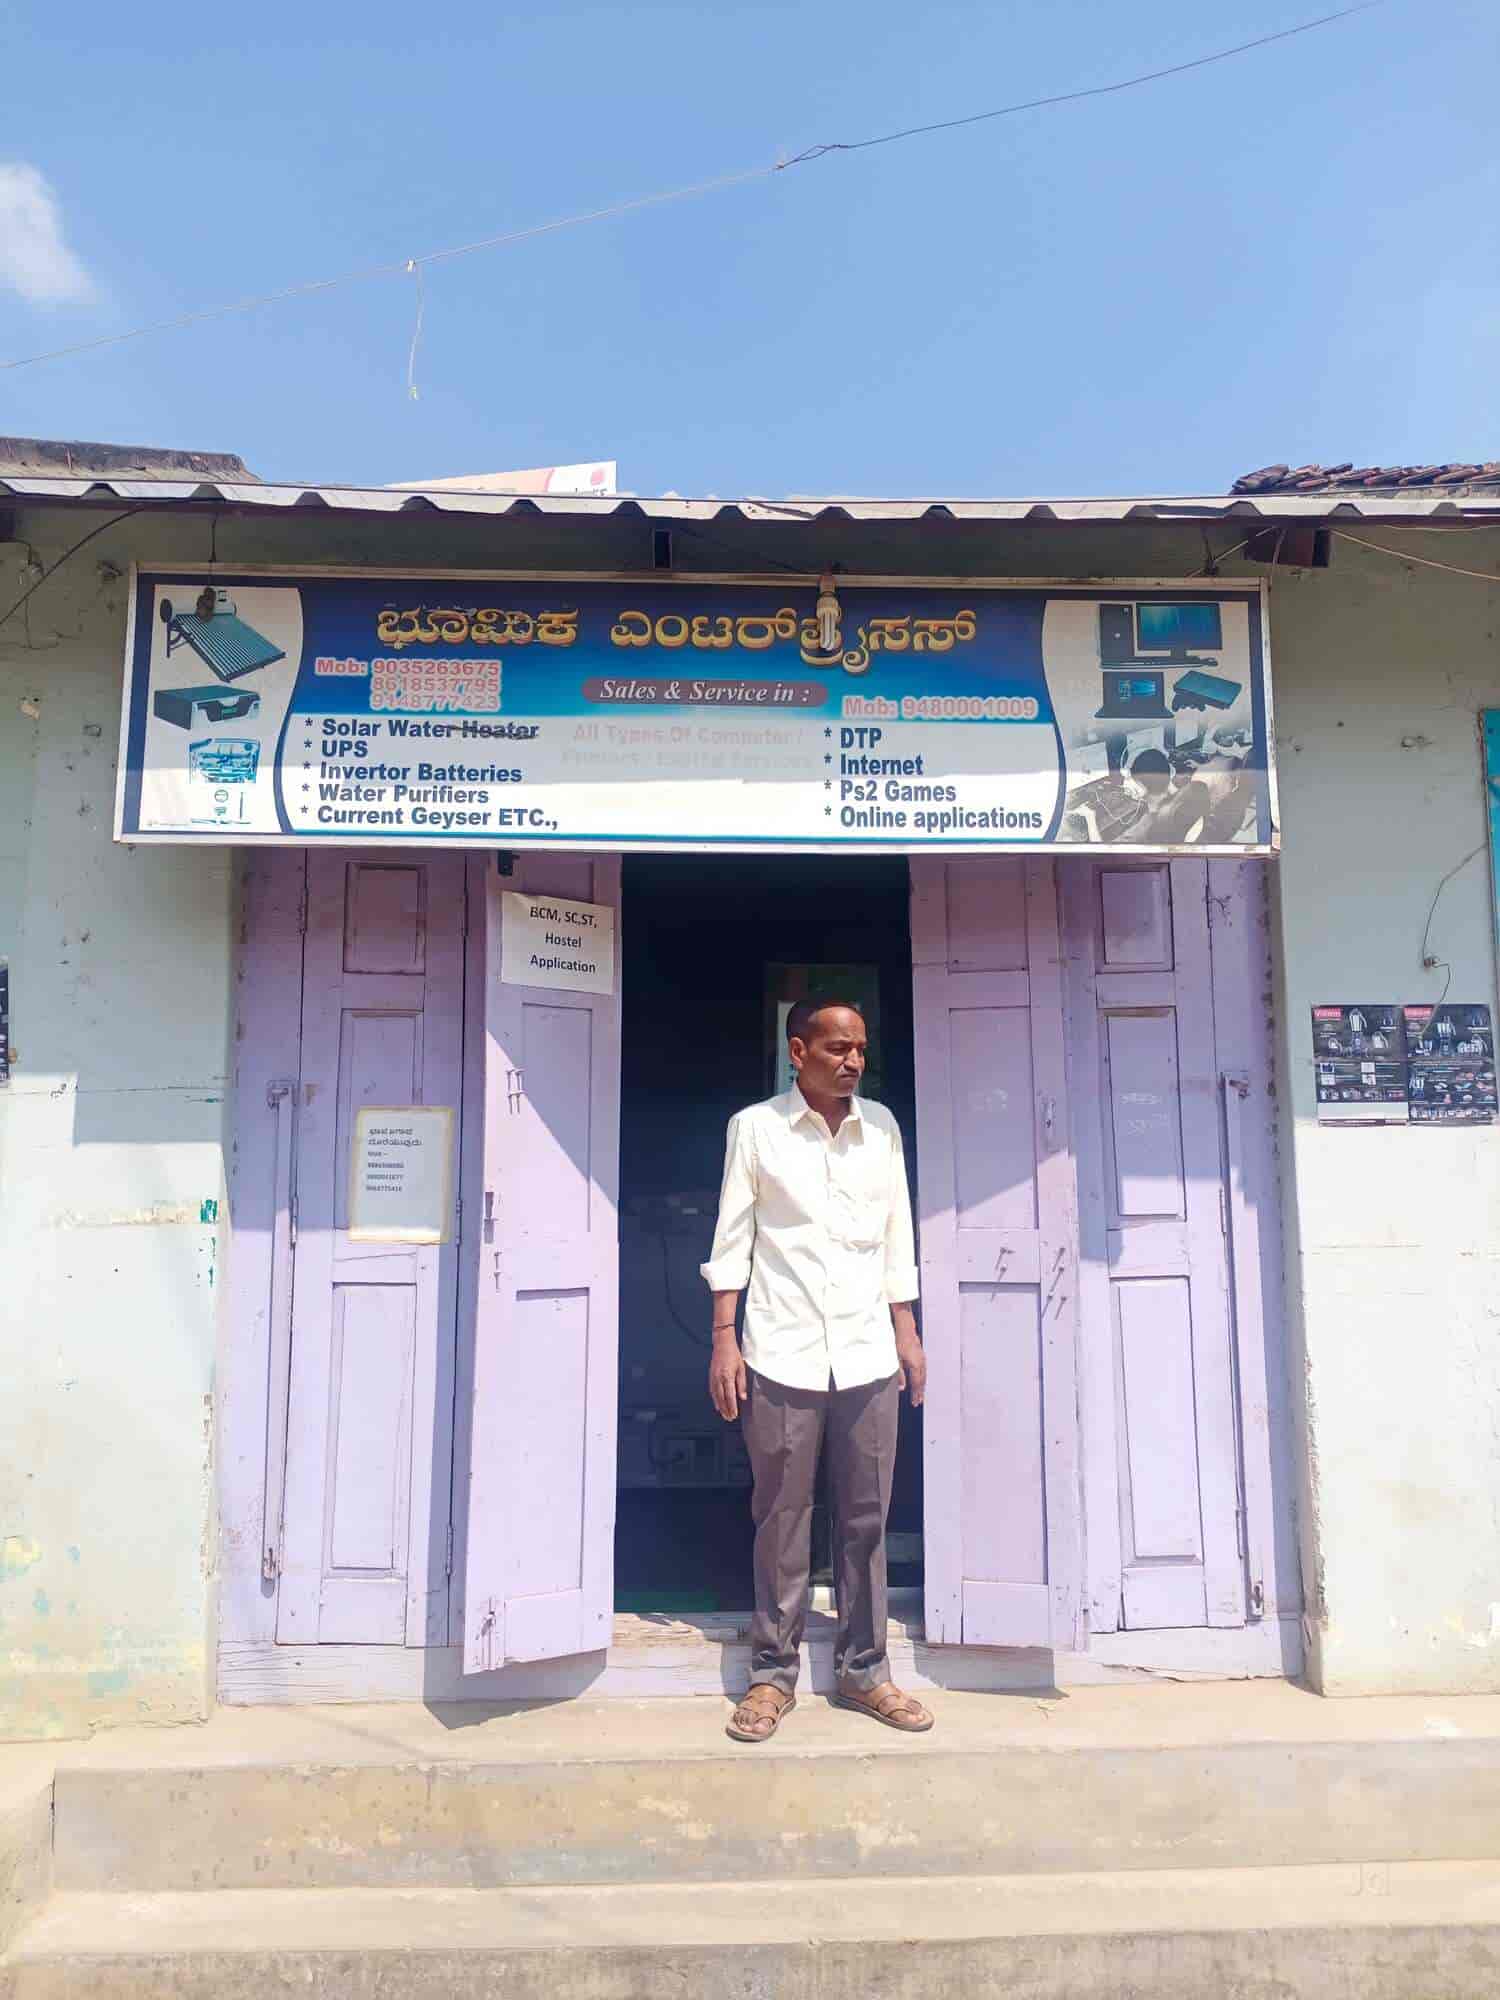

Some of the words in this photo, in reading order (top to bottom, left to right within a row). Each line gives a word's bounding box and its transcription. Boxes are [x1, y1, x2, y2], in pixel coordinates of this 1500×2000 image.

[315, 658, 367, 675] Mob:
[372, 659, 500, 676] 9035263675
[600, 680, 658, 700] Sales
[663, 681, 682, 700] &
[689, 681, 768, 702] Service
[843, 696, 897, 717] Mob:
[902, 697, 1037, 718] 9480001009
[322, 719, 381, 737] Solar
[388, 720, 453, 738] Water
[461, 720, 540, 739] Heater
[840, 727, 882, 748] DTP
[321, 740, 368, 757] UPS
[320, 761, 411, 780] Invertor
[418, 763, 523, 782] Batteries
[840, 753, 924, 775] Internet
[319, 783, 386, 802] Water
[394, 785, 489, 804] Purifiers
[840, 780, 878, 801] Ps2
[885, 780, 957, 802] Games
[318, 805, 404, 824] Current
[411, 807, 491, 829] Geyser
[499, 808, 558, 830] ETC.,
[840, 806, 907, 828] Online
[914, 807, 1043, 832] applications
[530, 906, 561, 923] BCM,
[545, 932, 582, 948] Hostel
[530, 954, 596, 973] Application
